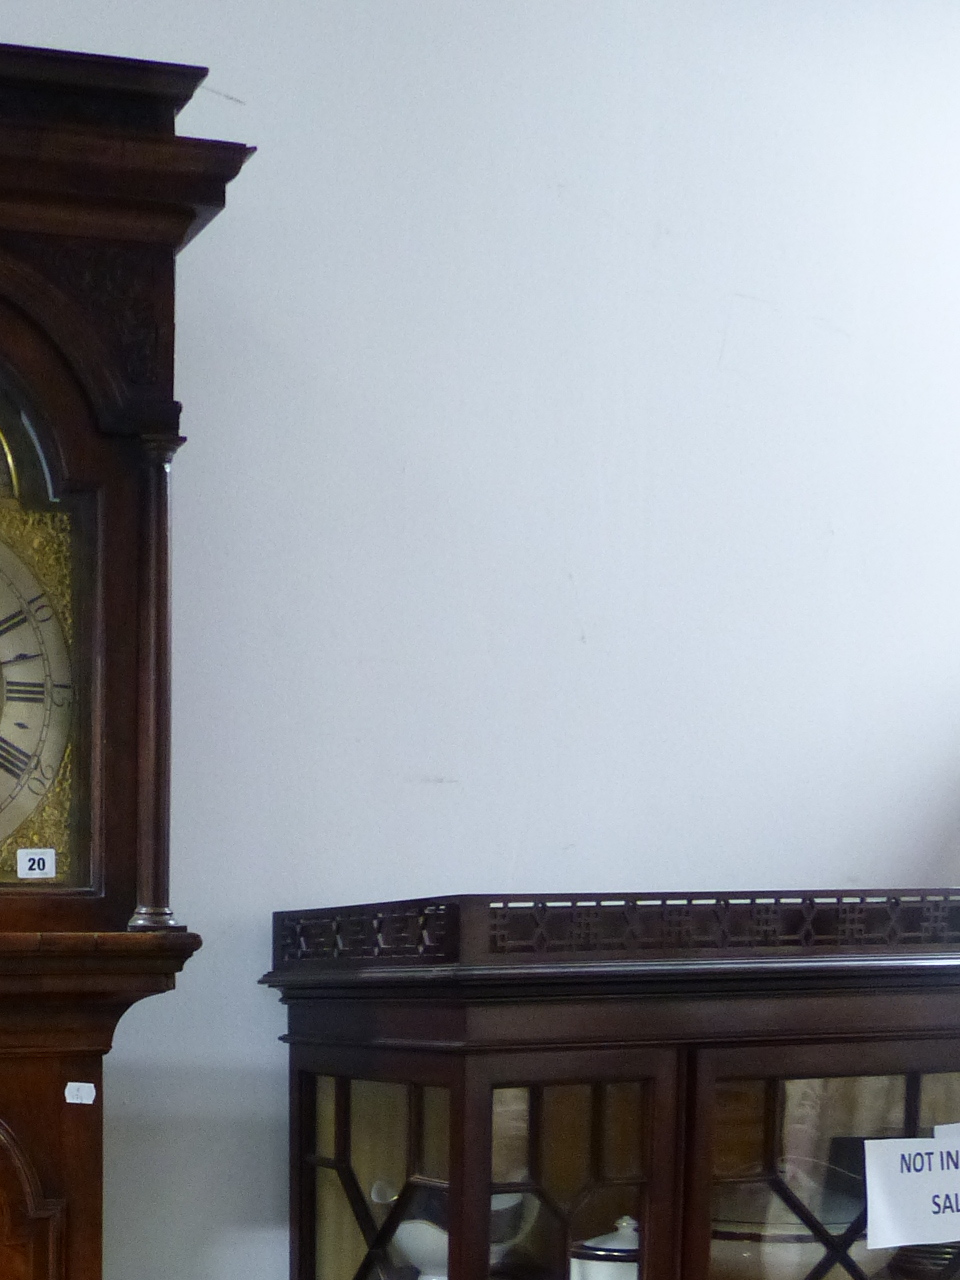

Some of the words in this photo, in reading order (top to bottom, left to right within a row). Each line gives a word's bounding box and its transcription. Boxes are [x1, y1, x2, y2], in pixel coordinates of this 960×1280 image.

[26, 592, 54, 623] 10
[6, 678, 46, 703] III
[28, 857, 46, 871] 20
[900, 1152, 934, 1174] NOT
[939, 1150, 960, 1171] IN
